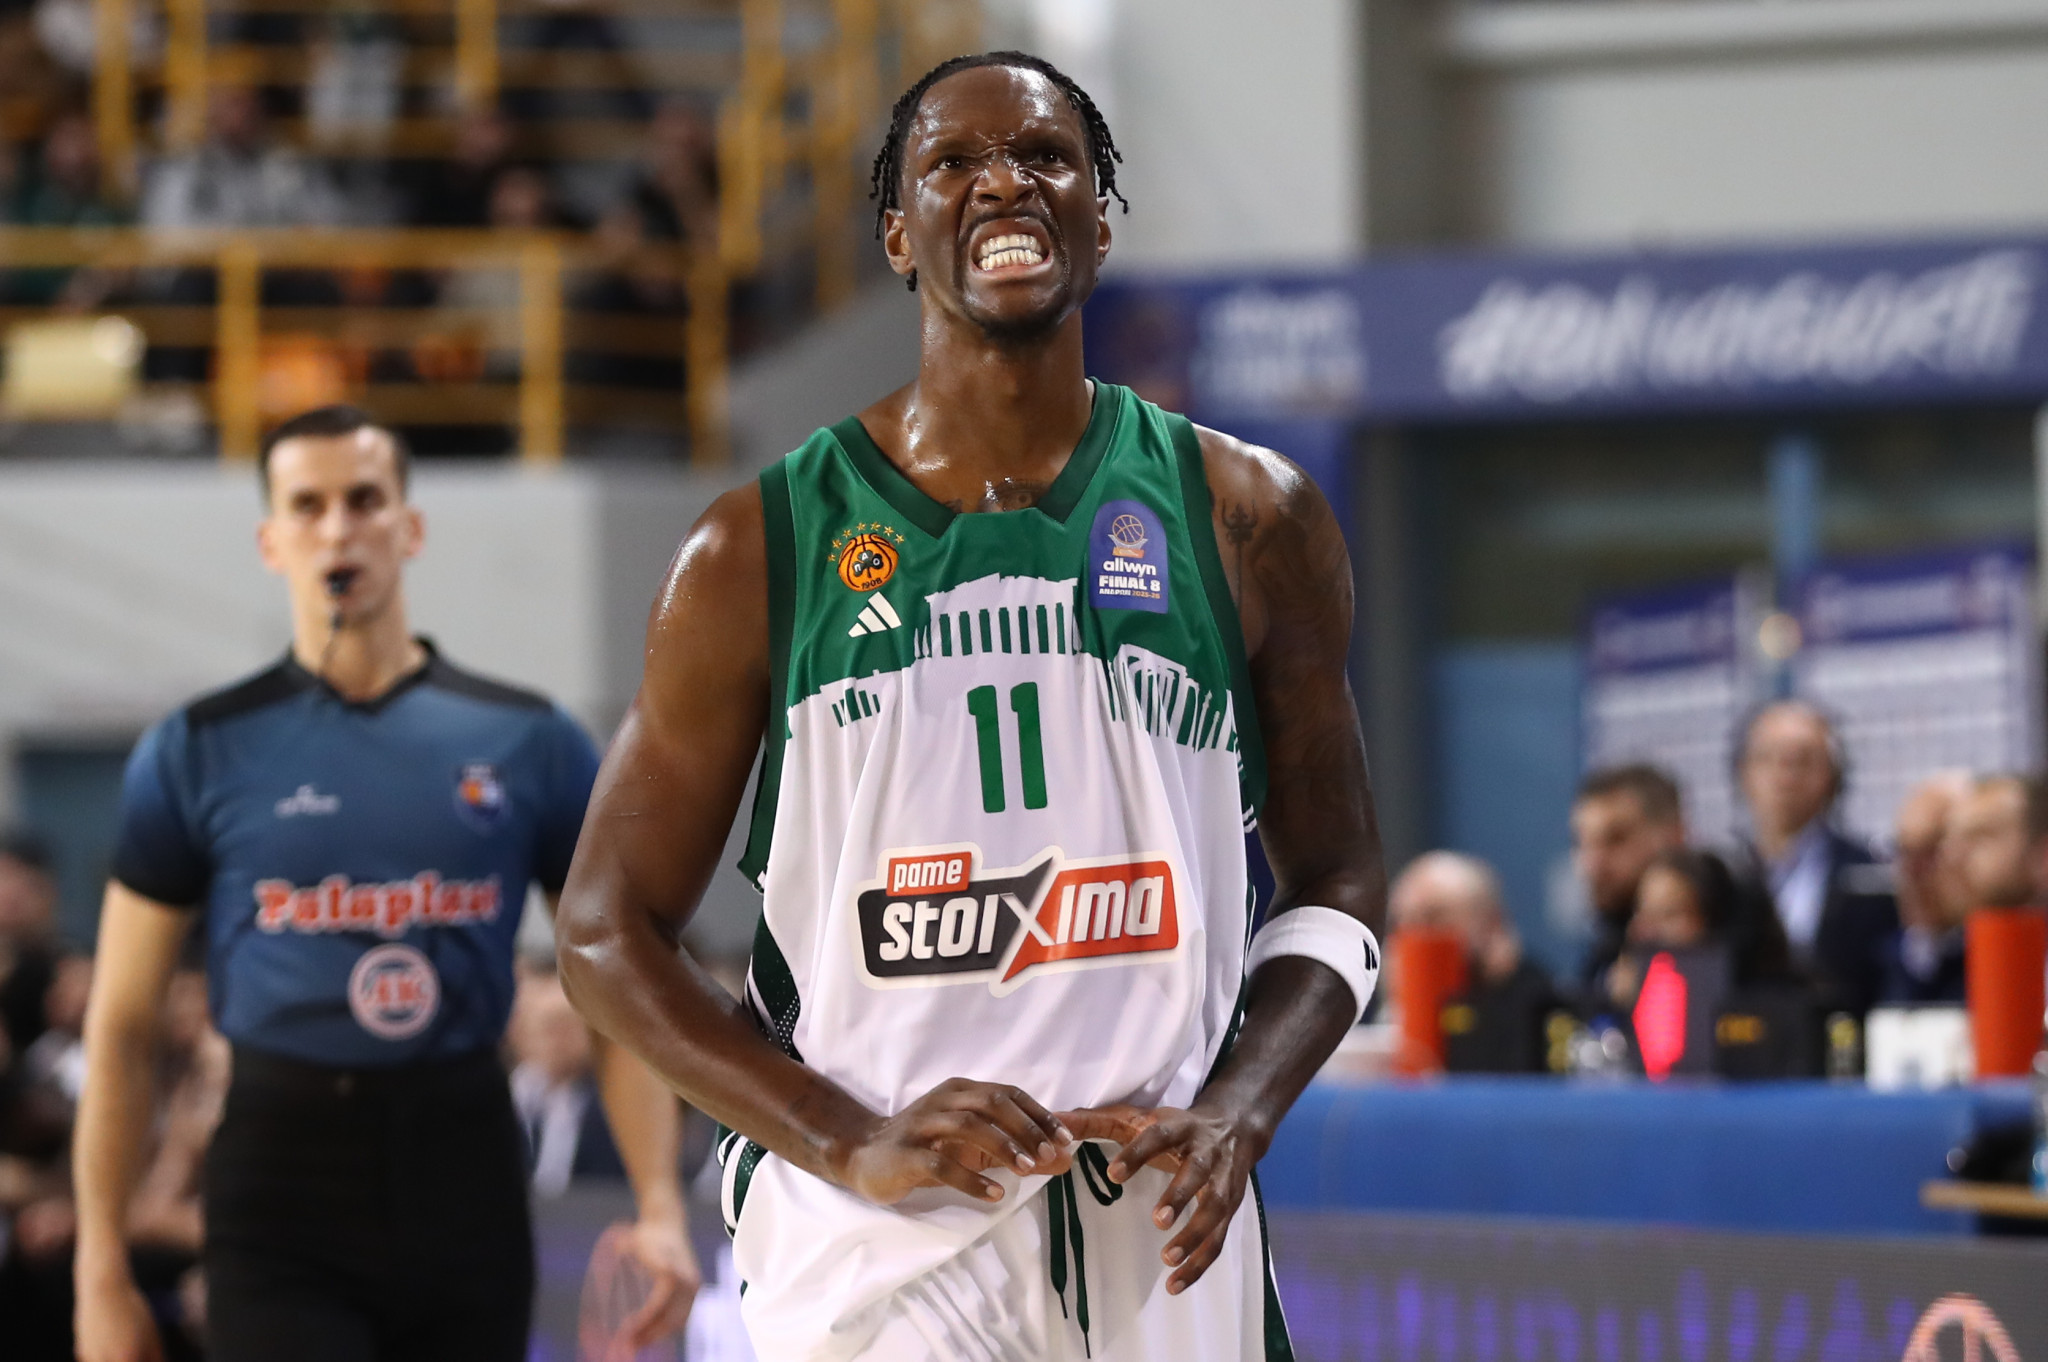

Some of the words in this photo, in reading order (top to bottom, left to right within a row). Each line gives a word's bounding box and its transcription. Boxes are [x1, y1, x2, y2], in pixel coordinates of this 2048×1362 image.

[1103, 557, 1156, 577] allwyn
[861, 578, 882, 589] 1908
[1099, 575, 1147, 590] FINAL
[1150, 580, 1161, 592] 8
[967, 681, 1048, 813] 11
[893, 858, 963, 892] pame
